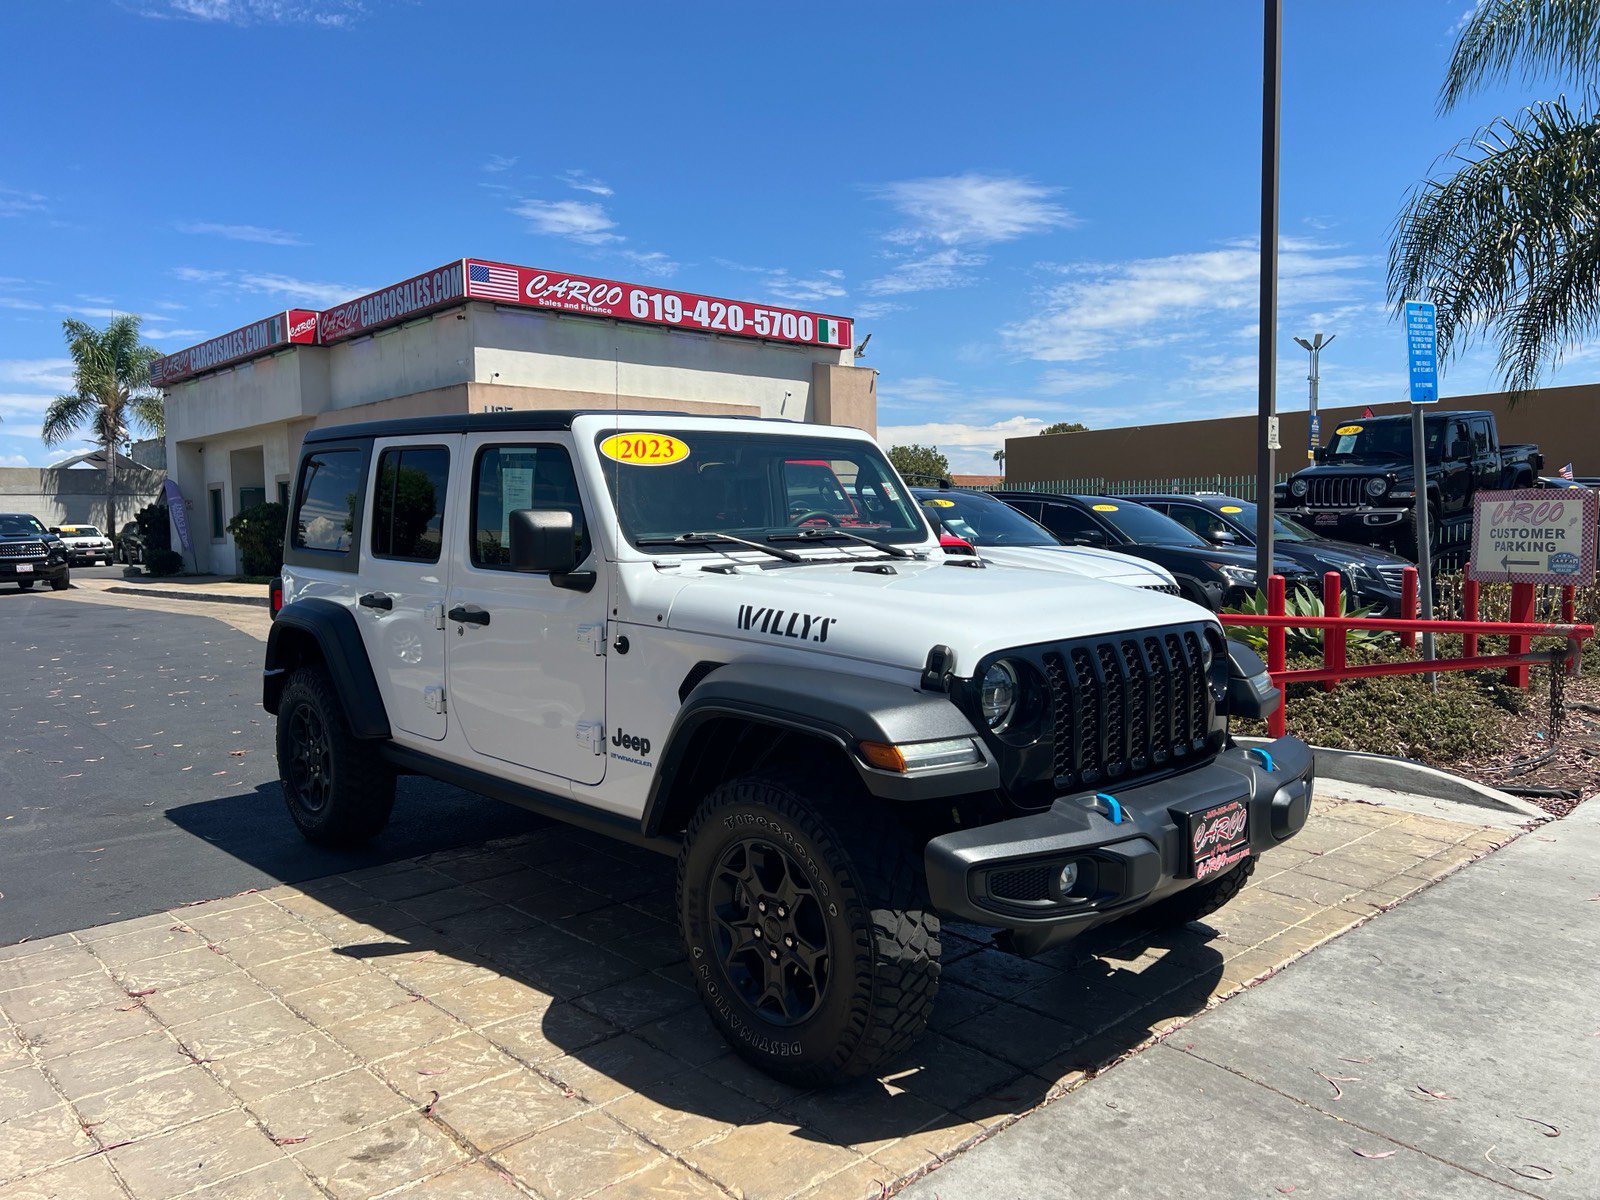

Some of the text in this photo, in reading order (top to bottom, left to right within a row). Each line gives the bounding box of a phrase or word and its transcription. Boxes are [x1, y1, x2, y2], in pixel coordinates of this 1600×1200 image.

[361, 264, 463, 328] CARCOSALES.COM
[525, 274, 623, 307] CARCO
[321, 303, 359, 337] CARCO
[539, 298, 612, 315] Sales and Finance
[629, 288, 814, 342] 619-420-5700
[289, 317, 317, 336] CARCO
[189, 321, 269, 372] CARCOSALES.COM
[162, 351, 189, 378] CARCO
[620, 439, 675, 459] 2023
[1491, 501, 1565, 527] CARCO
[1490, 528, 1566, 540] CUSTOMER
[1494, 541, 1557, 553] PARKING
[737, 604, 837, 643] WILLYS
[612, 727, 651, 757] Jeep
[617, 753, 653, 768] WRANGLER
[1193, 808, 1247, 854] CARCO
[723, 813, 830, 897] Firestone
[698, 963, 803, 1057] DESTINATION
